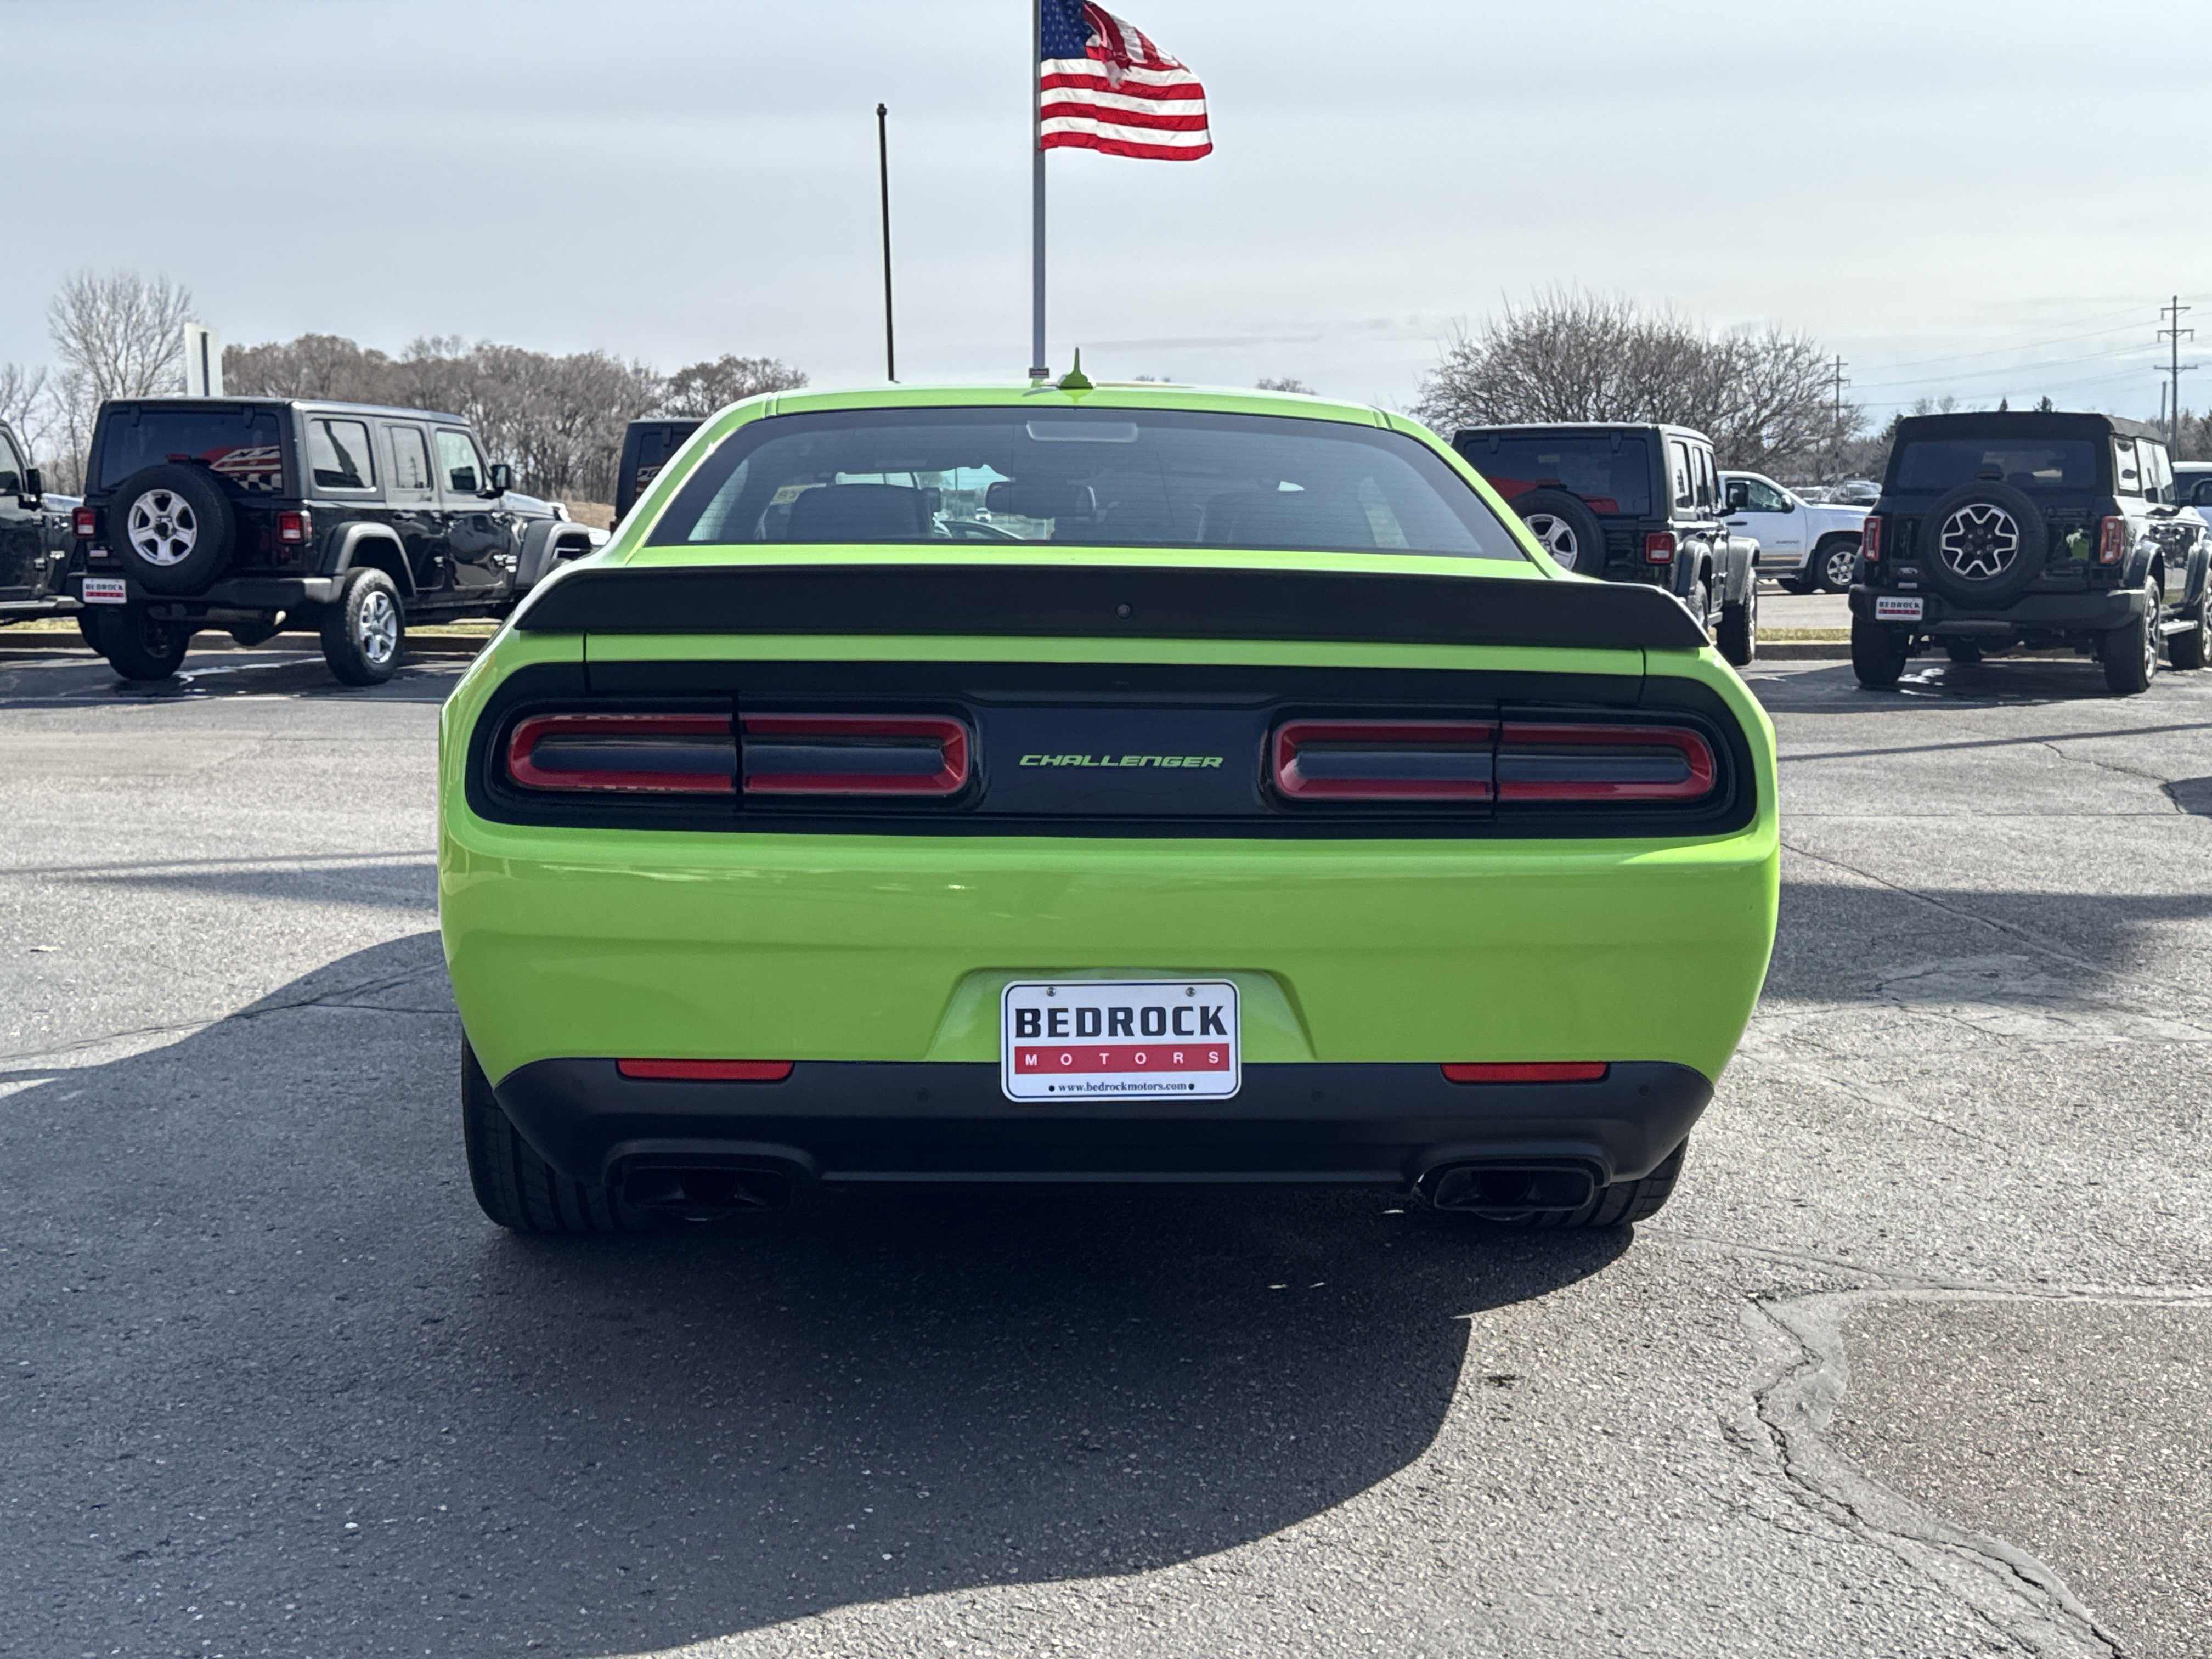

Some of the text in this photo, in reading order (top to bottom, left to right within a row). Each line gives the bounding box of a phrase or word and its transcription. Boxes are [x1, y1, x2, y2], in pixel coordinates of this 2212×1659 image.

[1019, 754, 1224, 768] CHALLENGER
[1015, 1005, 1228, 1038] BEDROCK
[1025, 1051, 1220, 1066] MOTORS
[1058, 1081, 1187, 1092] www.bedrockmotors.com
